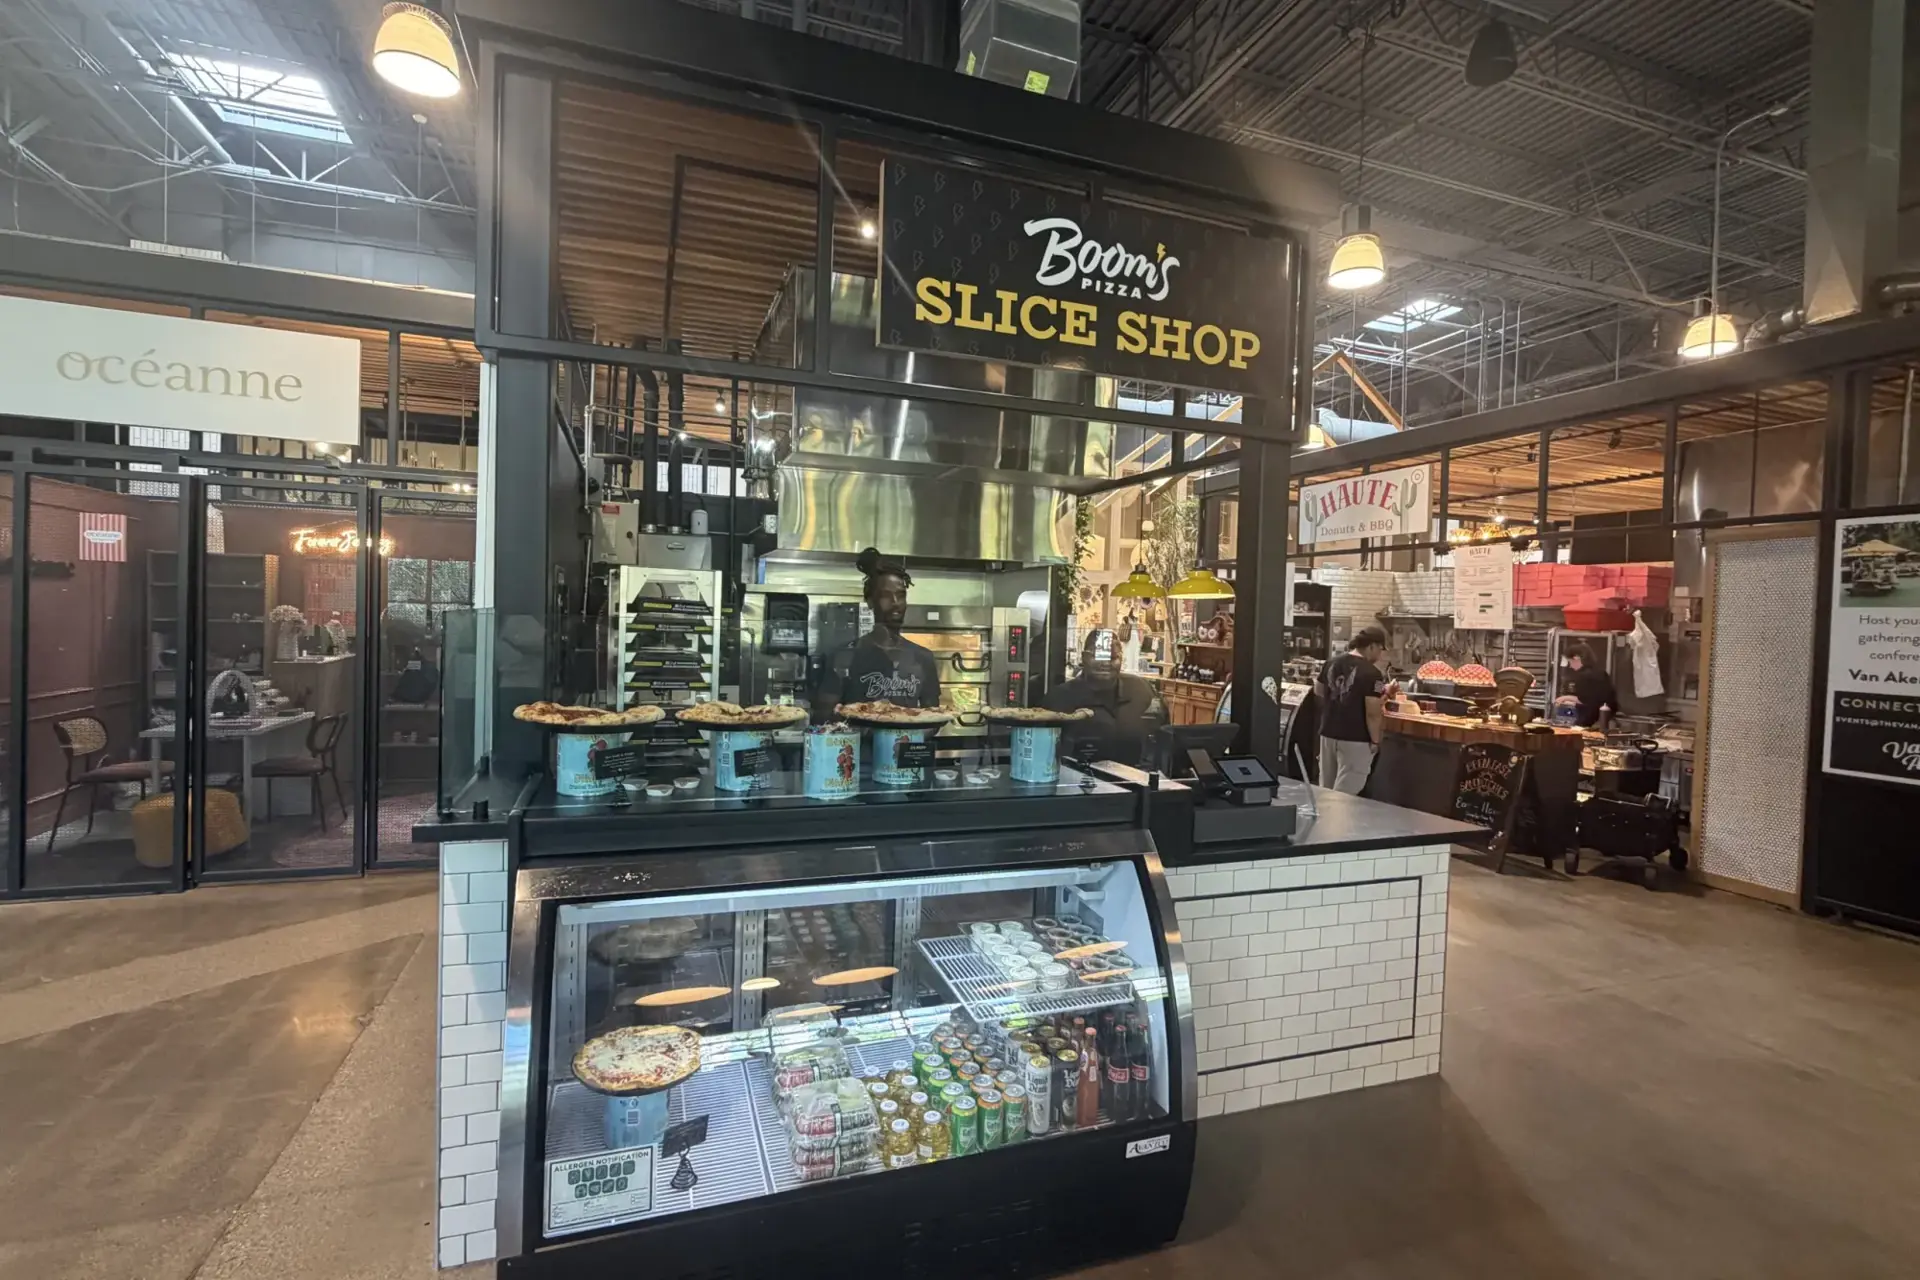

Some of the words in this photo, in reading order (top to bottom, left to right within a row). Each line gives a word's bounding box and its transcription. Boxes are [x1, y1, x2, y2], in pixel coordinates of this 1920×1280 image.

[1023, 217, 1180, 302] Boom's
[1080, 277, 1142, 300] PIZZA
[915, 276, 1098, 347] SLICE
[1116, 310, 1261, 370] SHOP
[56, 348, 302, 402] océanne
[1320, 479, 1398, 519] HAUTE
[1320, 524, 1356, 537] Donuts
[1358, 522, 1366, 532] &
[1370, 519, 1394, 532] BBQ
[1859, 614, 1890, 626] Host
[1858, 632, 1920, 646] gathering
[1848, 668, 1880, 683] Van
[553, 1160, 594, 1173] ALLERGEN
[596, 1151, 649, 1165] NOTIFICATION
